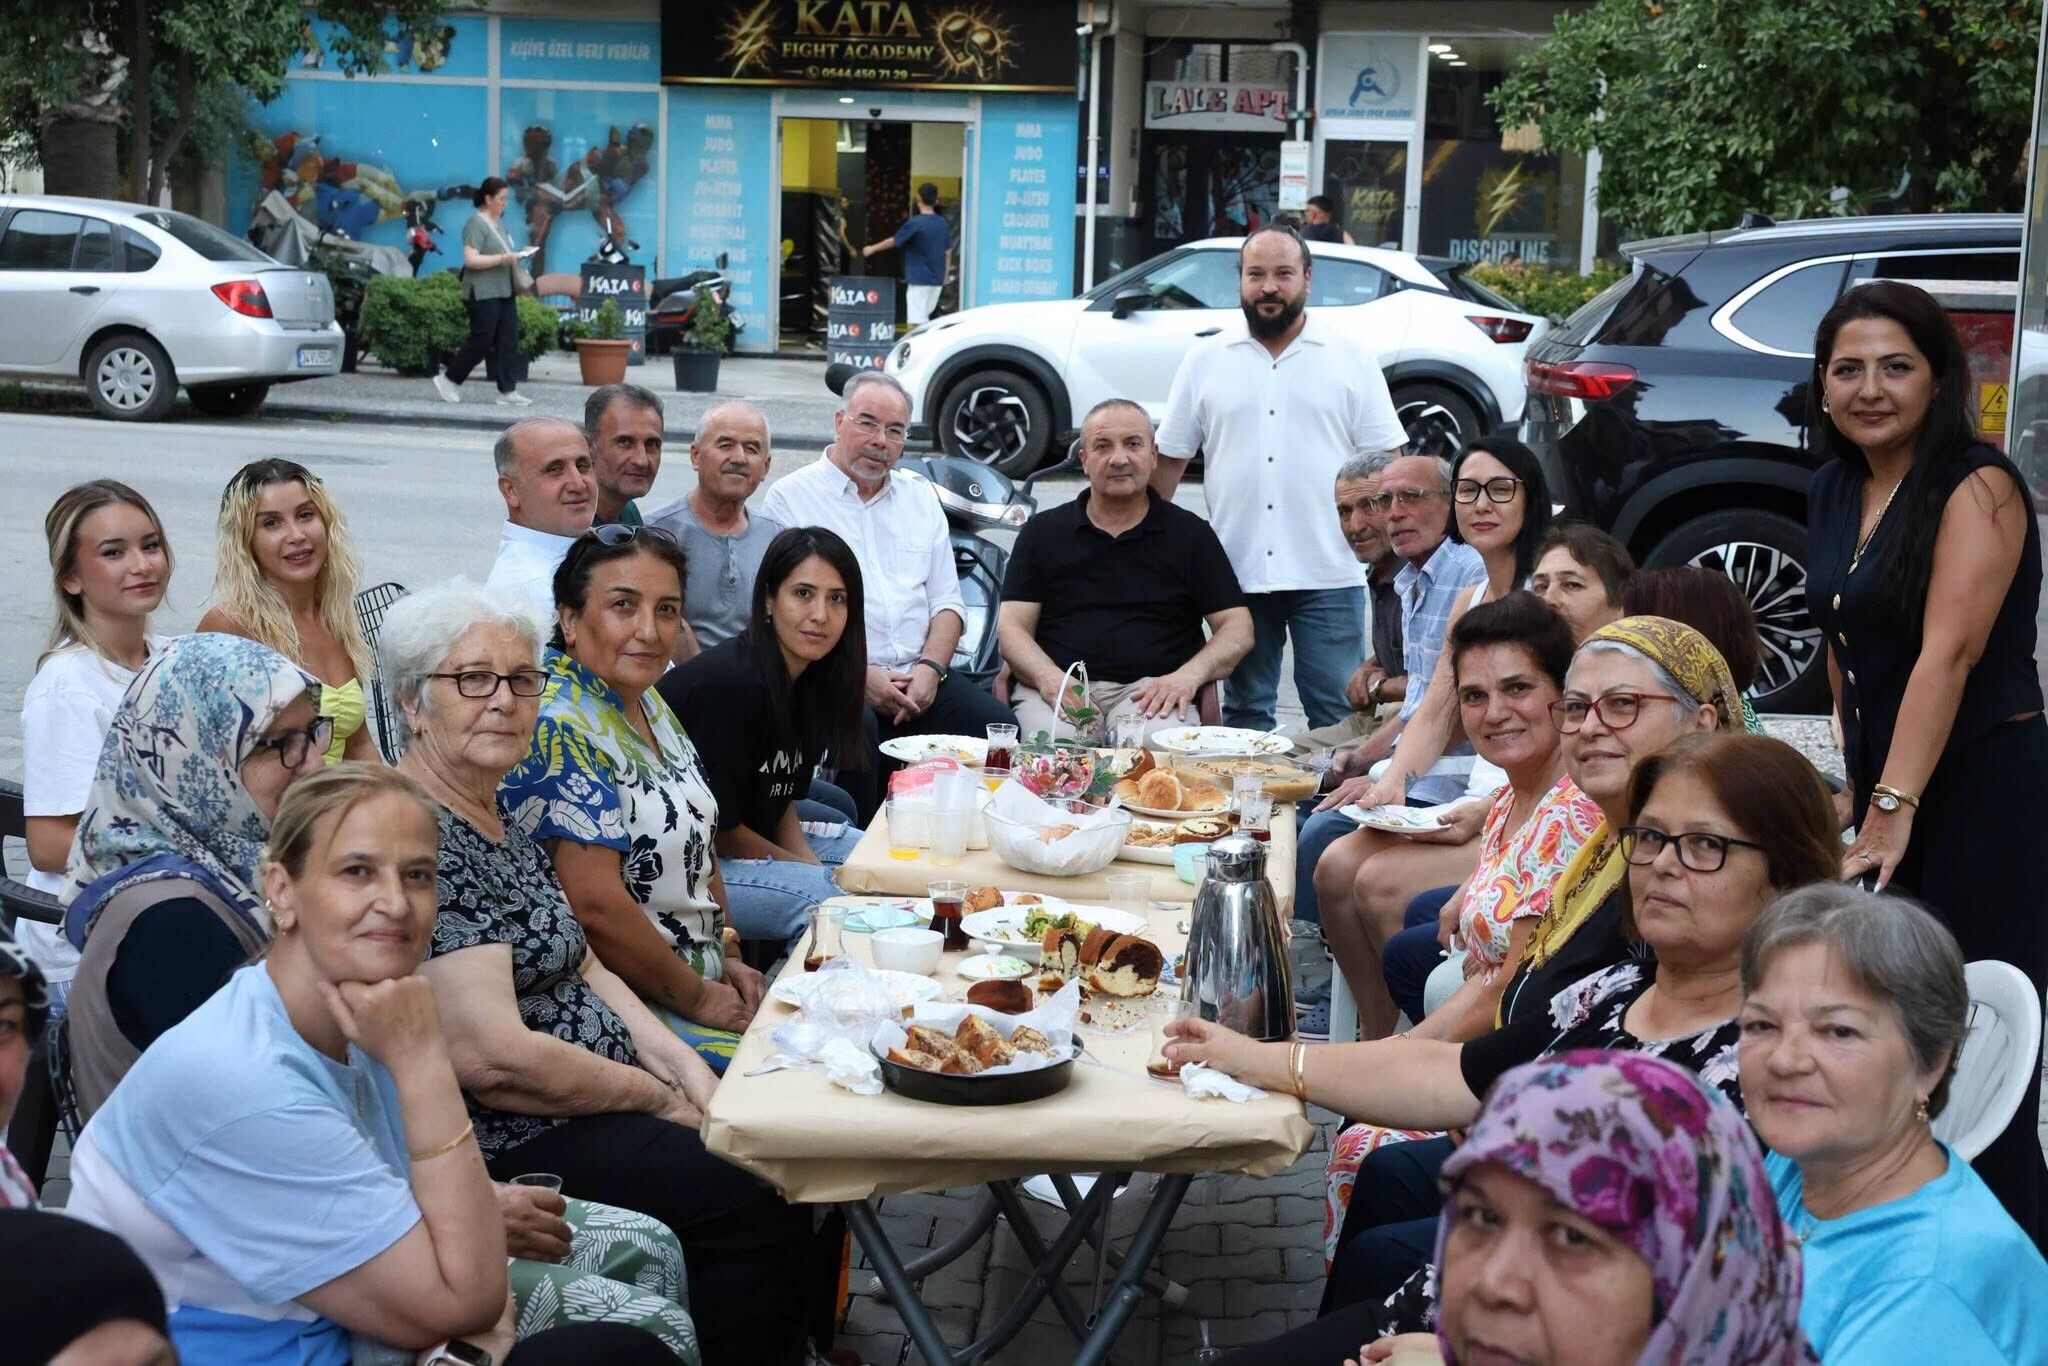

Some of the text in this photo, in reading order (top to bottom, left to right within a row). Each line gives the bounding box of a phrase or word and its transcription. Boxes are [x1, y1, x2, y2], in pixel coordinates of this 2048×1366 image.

[794, 0, 921, 37] KATA
[577, 42, 604, 59] DERS
[781, 42, 935, 61] FIGHT ACADEMY
[821, 67, 850, 79] 0544
[853, 68, 877, 80] 450
[1152, 86, 1228, 120] LALE
[704, 136, 735, 152] JUDO
[1014, 145, 1043, 161] JUDO
[1351, 186, 1396, 208] KATA
[588, 275, 629, 294] KATA
[831, 286, 866, 306] KATA
